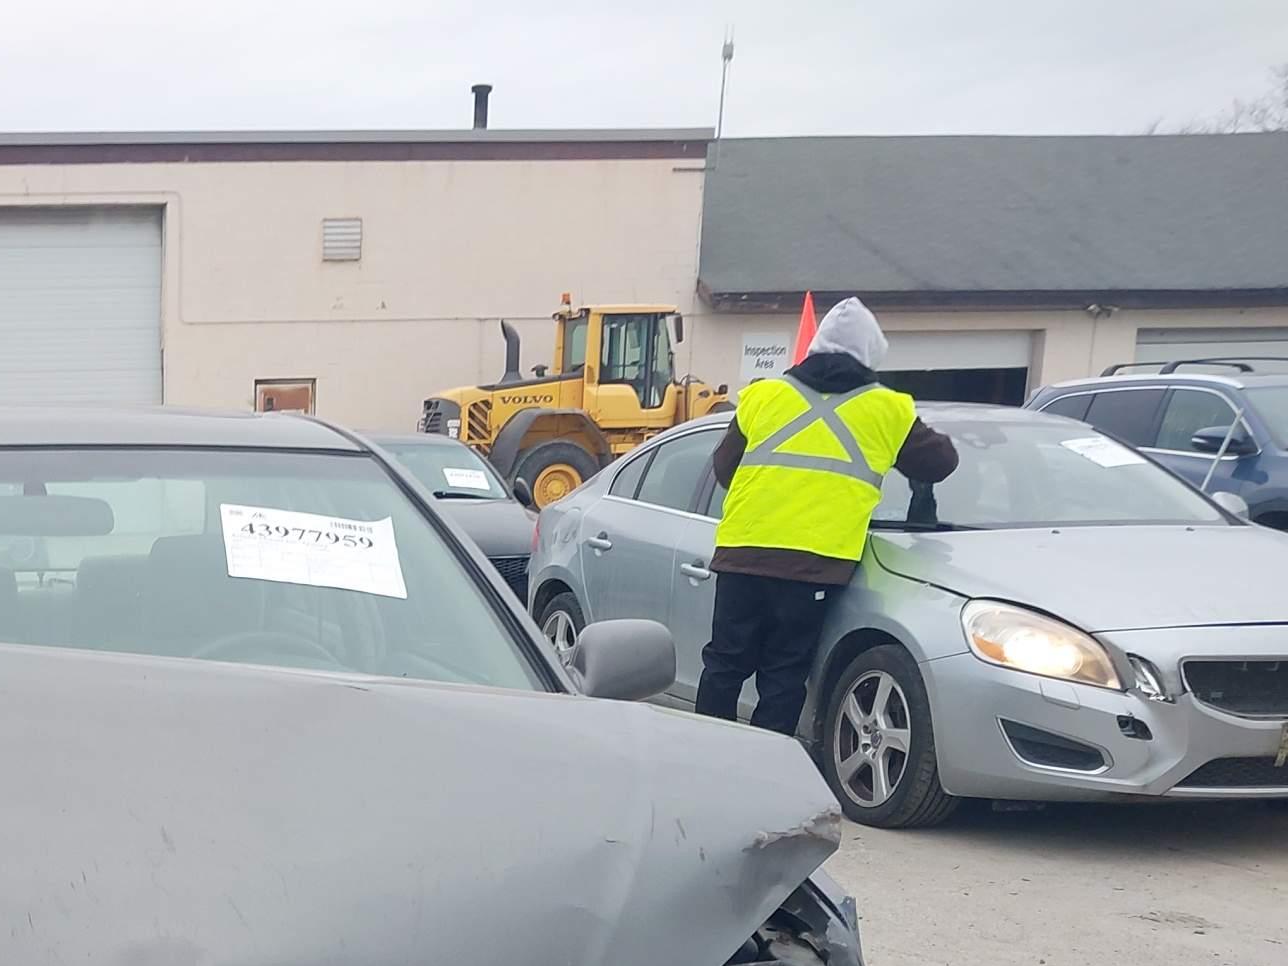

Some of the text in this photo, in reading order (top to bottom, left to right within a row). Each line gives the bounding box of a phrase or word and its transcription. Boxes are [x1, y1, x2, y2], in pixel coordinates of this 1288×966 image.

[744, 345, 786, 357] Inspection
[755, 358, 775, 369] Area
[501, 394, 554, 405] VOLVO
[240, 522, 374, 549] 43977959
